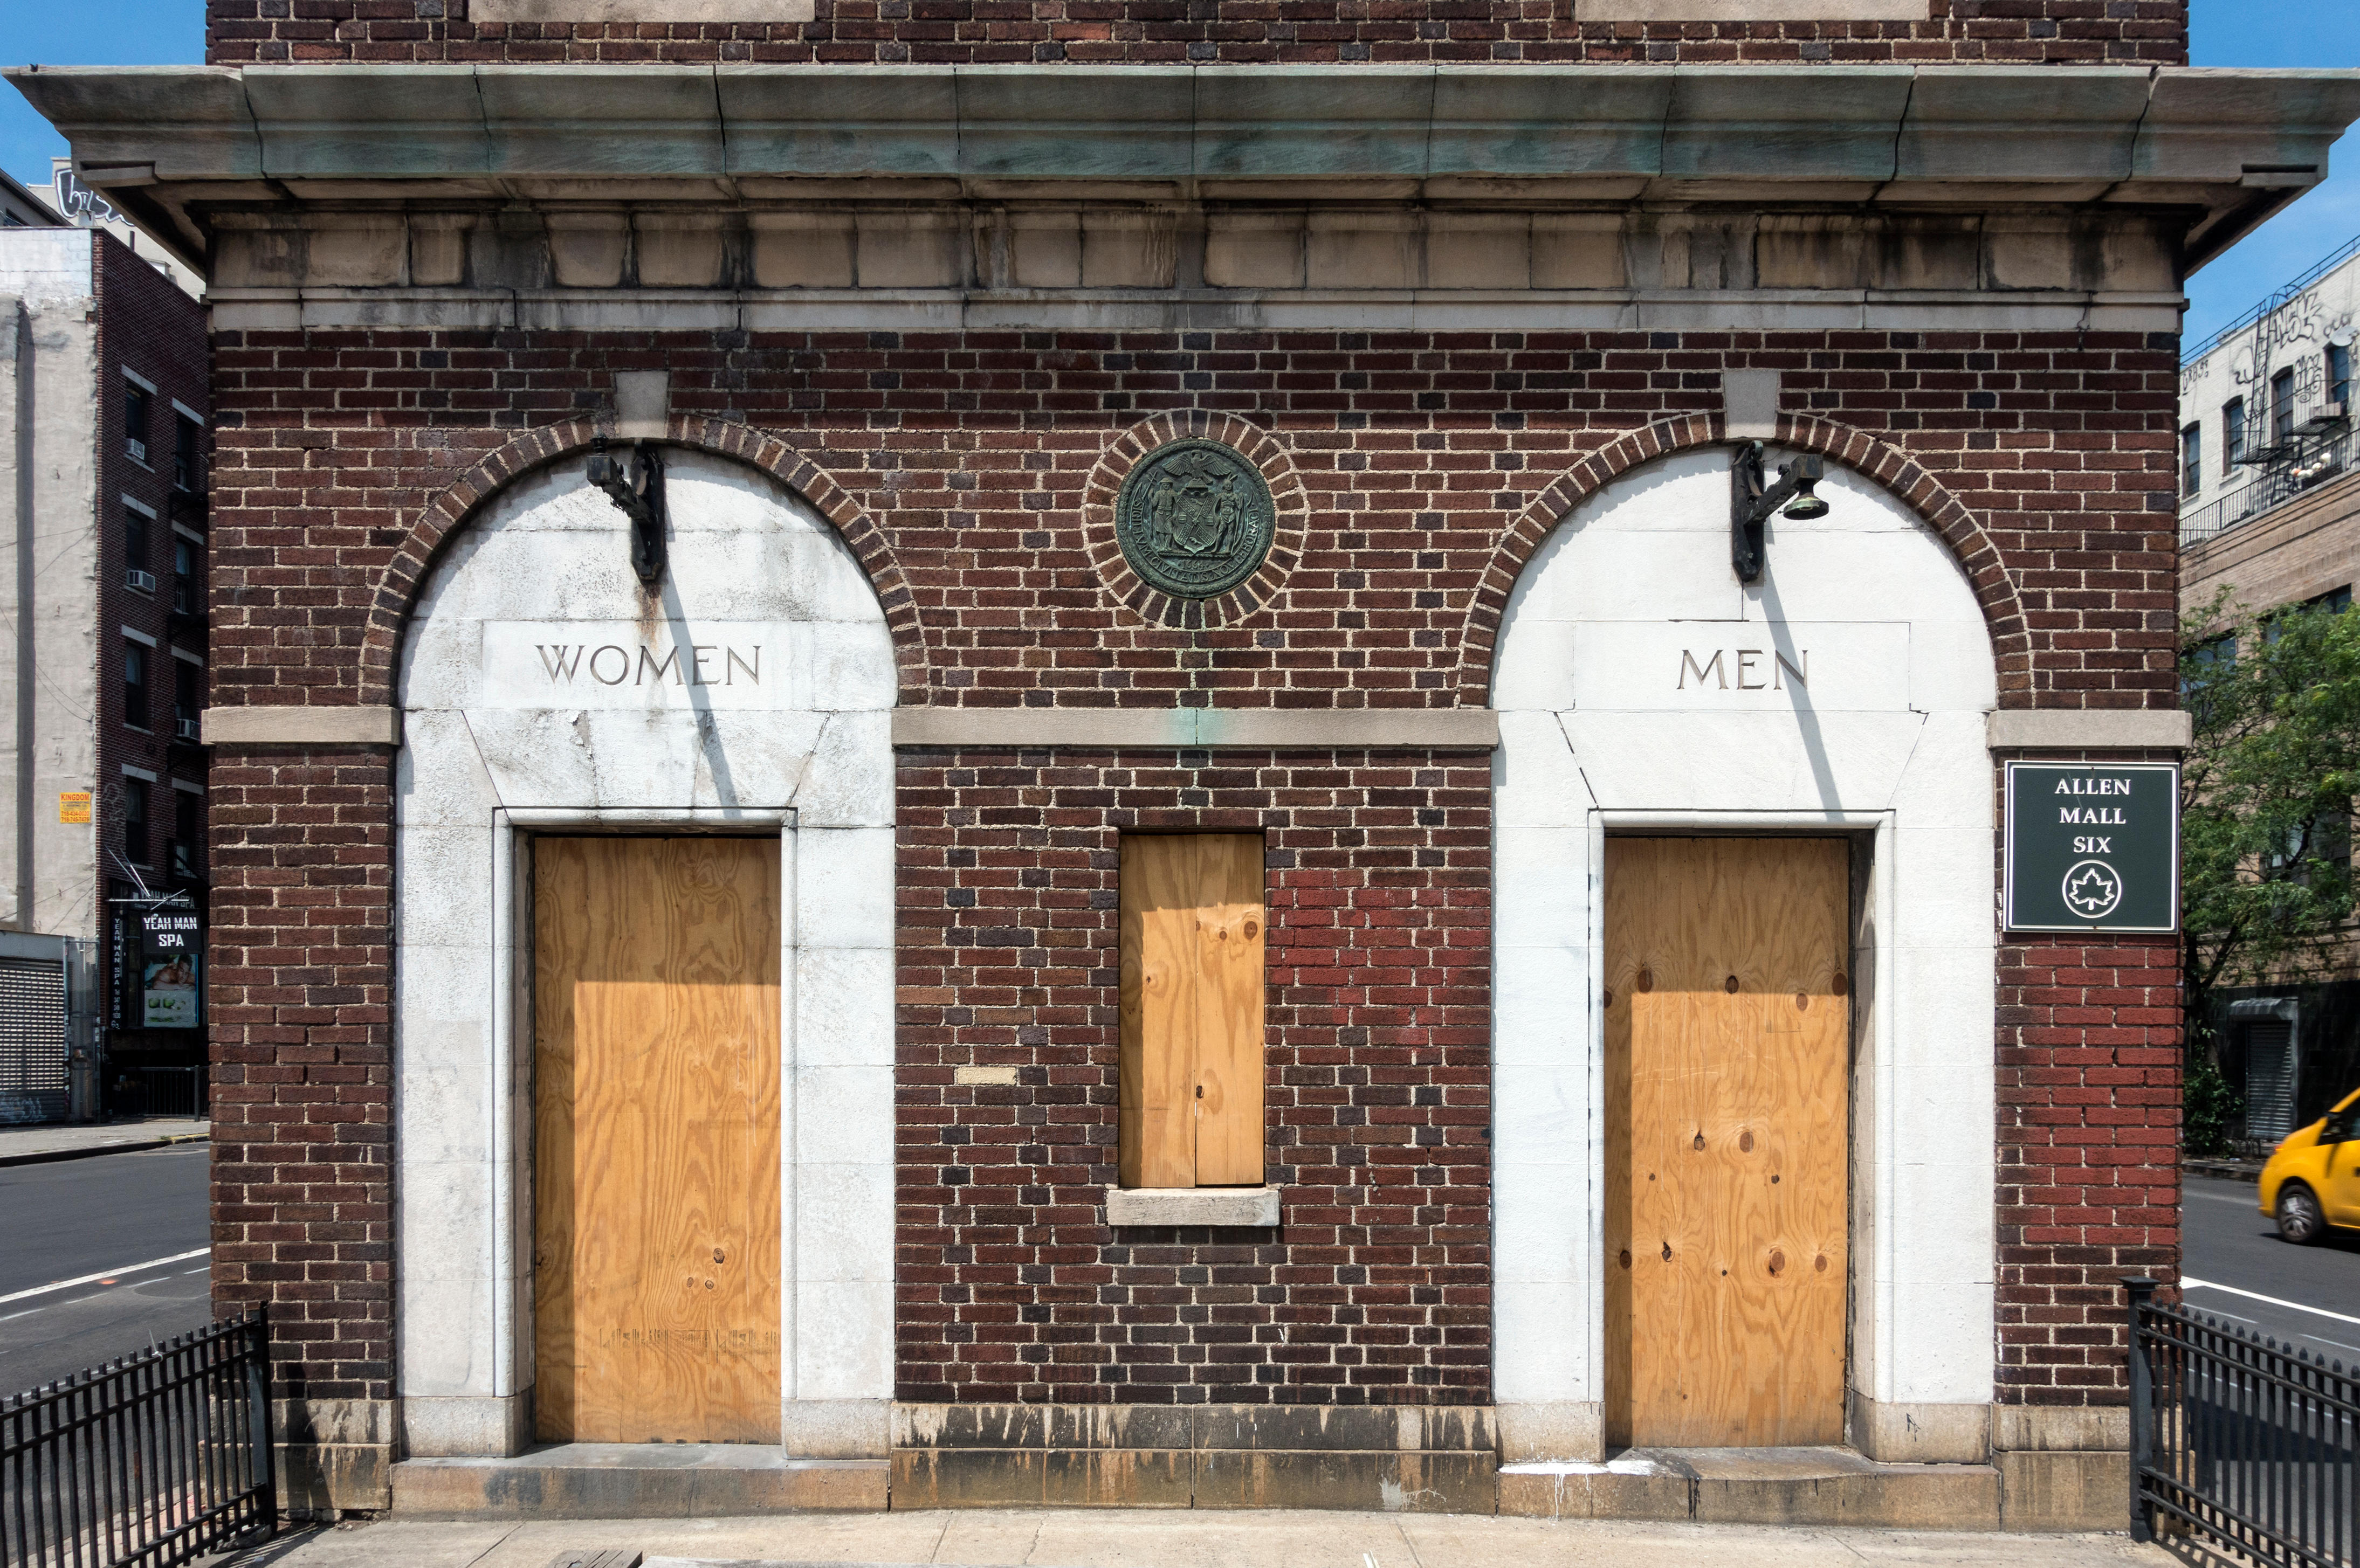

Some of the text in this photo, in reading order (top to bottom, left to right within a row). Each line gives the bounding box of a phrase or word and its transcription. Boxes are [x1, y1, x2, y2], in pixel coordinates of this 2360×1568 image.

[534, 645, 762, 686] WOMEN
[1676, 649, 1808, 690] MEN
[2054, 778, 2131, 796] ALLEN
[2059, 807, 2127, 824] MALL
[2073, 836, 2111, 853] SIX
[143, 917, 198, 930] YEAH MAN
[159, 934, 184, 947] SPA
